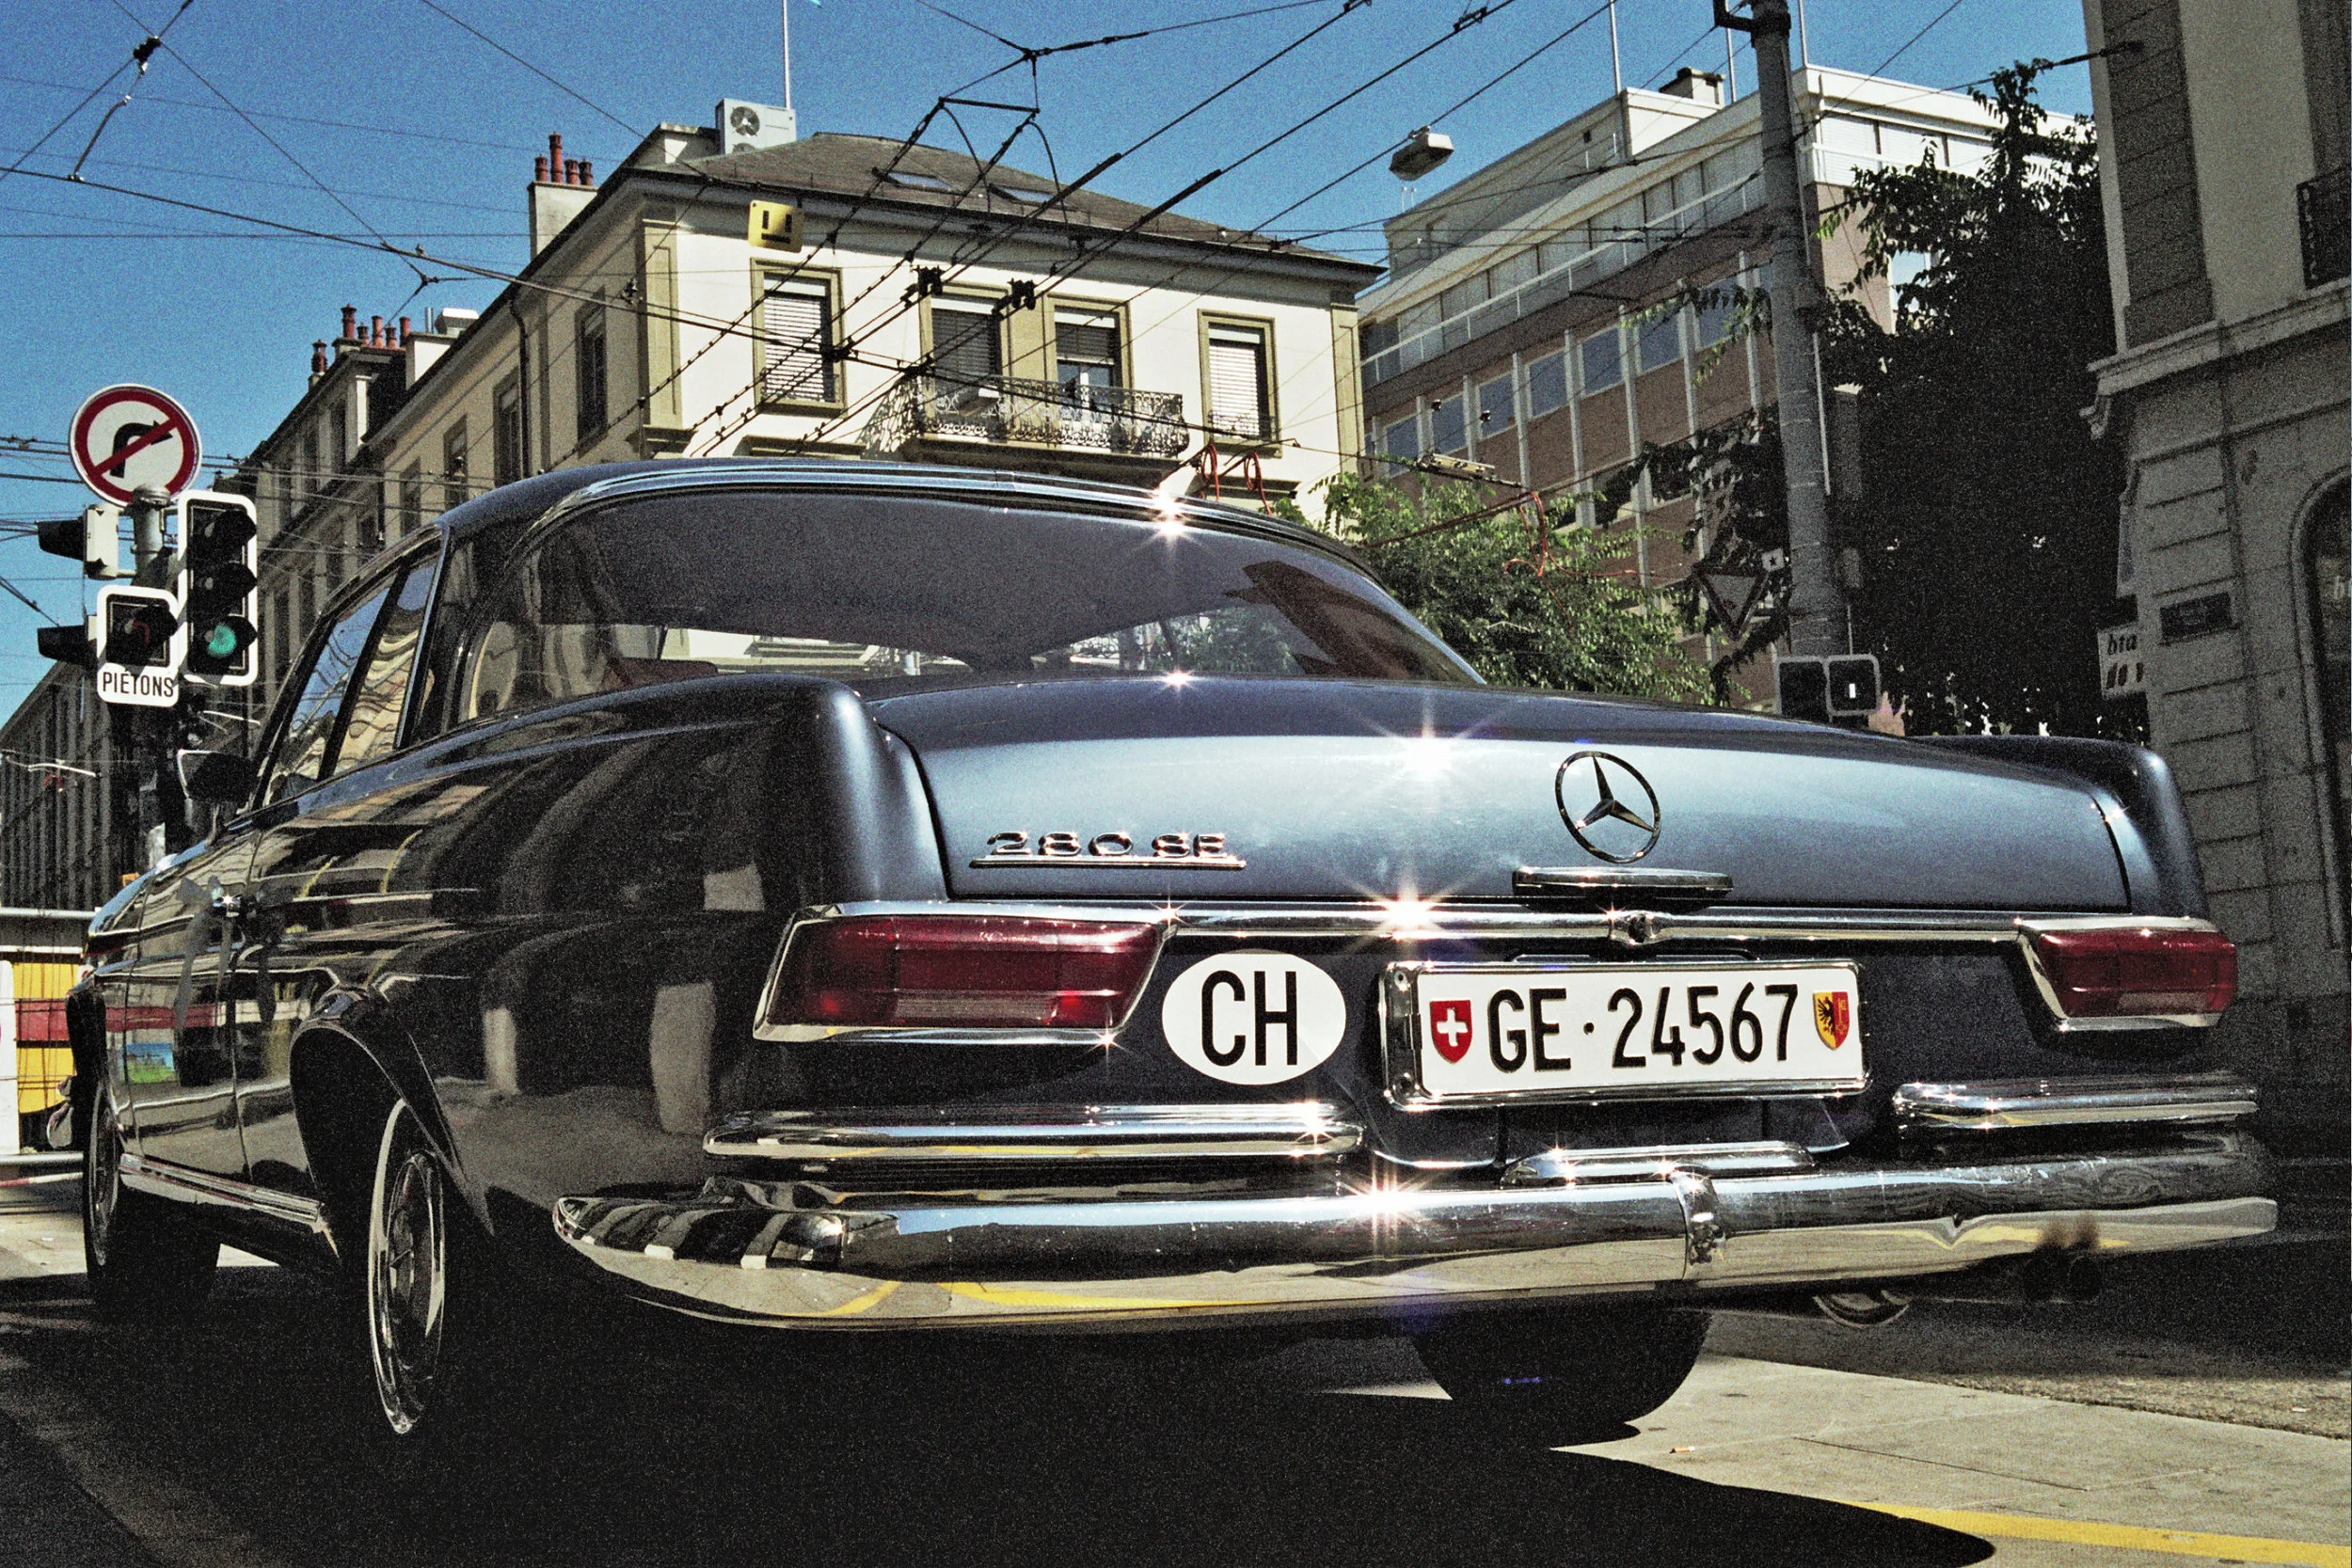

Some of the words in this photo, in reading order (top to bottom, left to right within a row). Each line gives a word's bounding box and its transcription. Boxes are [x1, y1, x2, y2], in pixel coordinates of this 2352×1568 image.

[987, 831, 1134, 856] 280
[1152, 832, 1227, 858] SE
[1201, 970, 1297, 1067] CH
